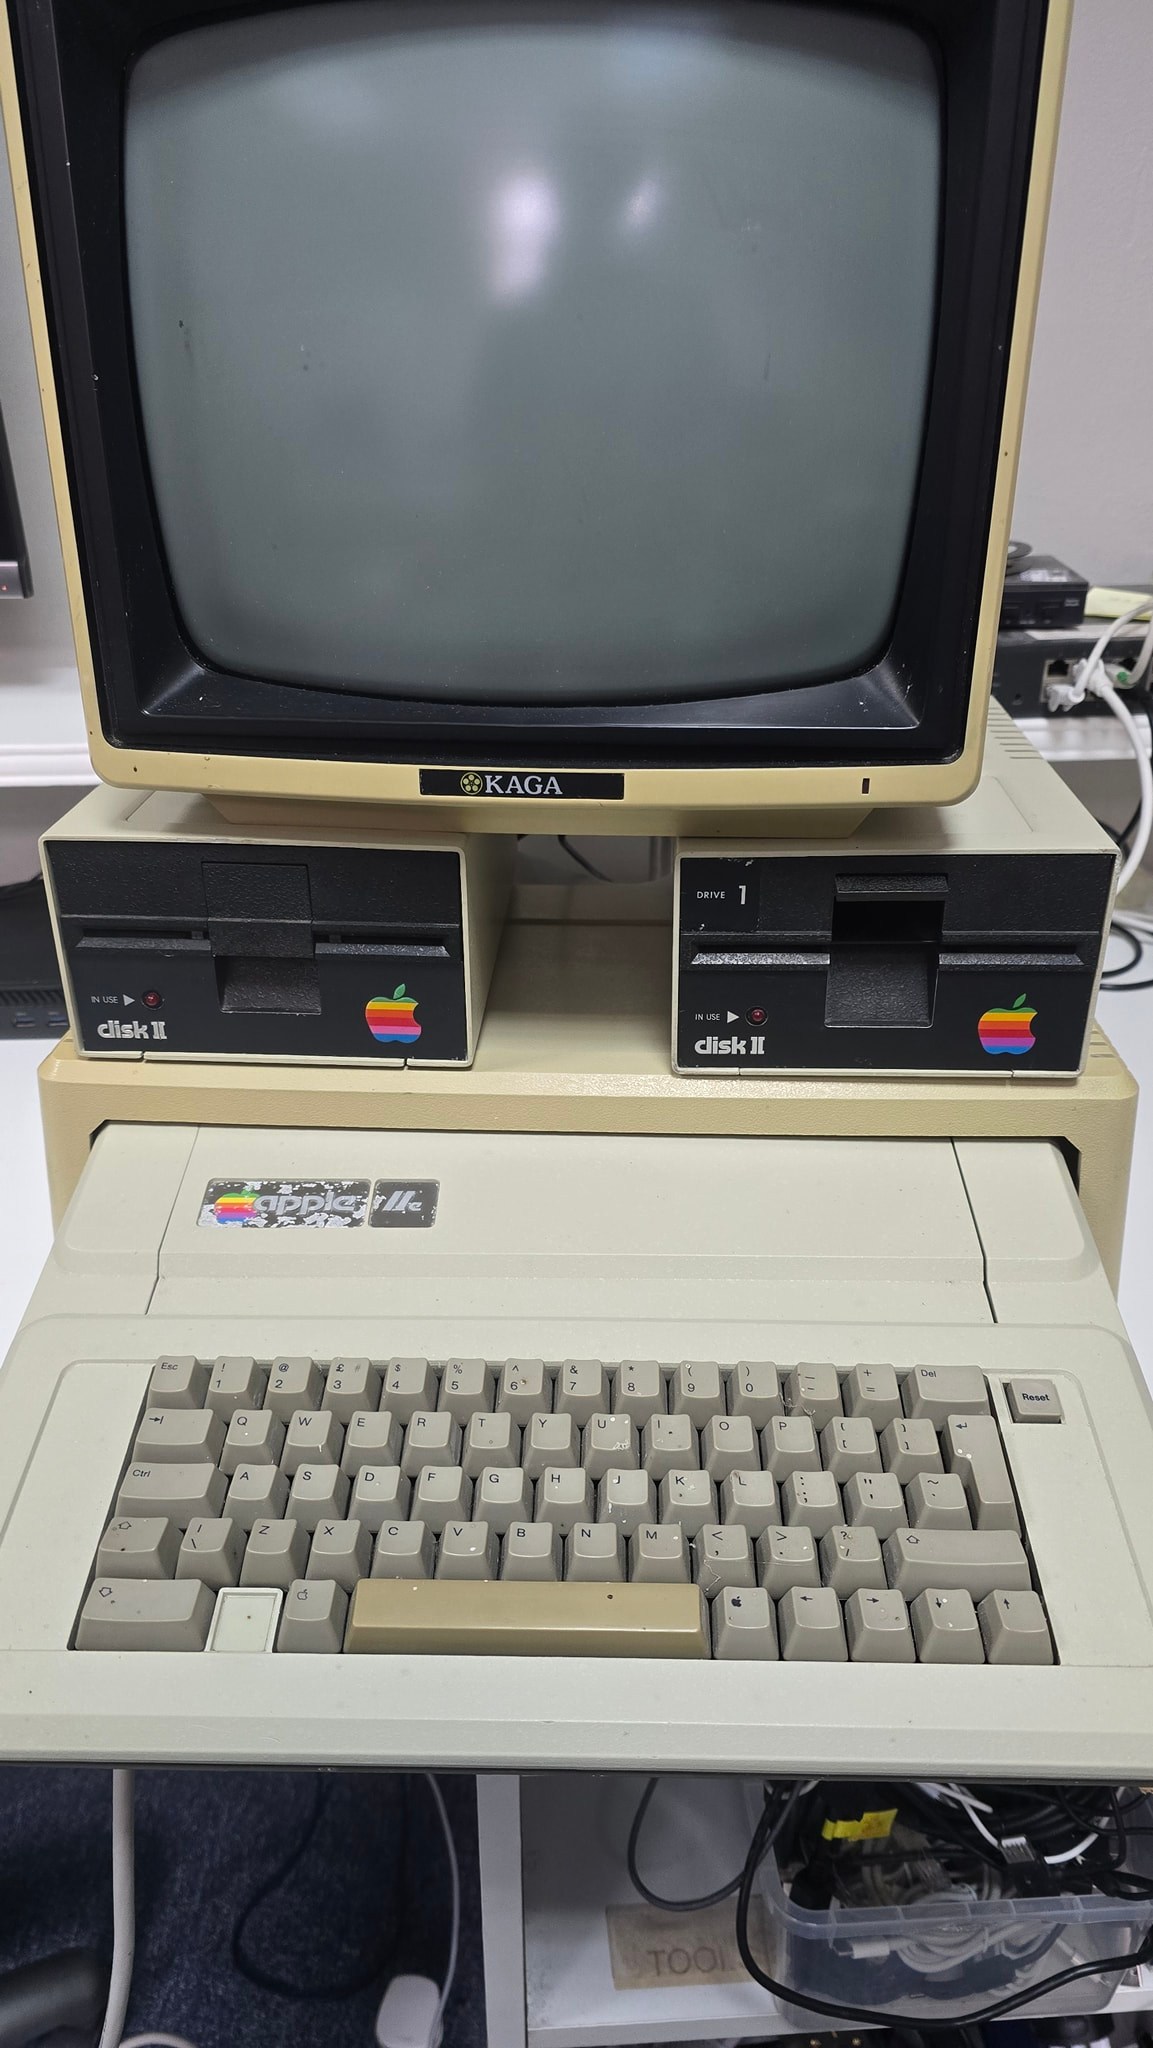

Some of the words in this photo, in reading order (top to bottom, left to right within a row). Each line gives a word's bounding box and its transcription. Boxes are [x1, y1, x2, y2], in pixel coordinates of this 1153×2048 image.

[484, 775, 563, 795] KAGA
[696, 891, 726, 899] DRIVE
[738, 885, 747, 905] 1
[102, 996, 119, 1004] USE
[695, 1013, 704, 1021] IN
[706, 1013, 720, 1021] USE
[97, 1020, 150, 1039] disk
[694, 1036, 747, 1055] disk
[253, 1190, 356, 1215] apple
[160, 1362, 178, 1371] Esc
[278, 1363, 290, 1373] @
[336, 1363, 345, 1373] £
[394, 1364, 401, 1373] $
[453, 1364, 463, 1375] %
[569, 1365, 579, 1375] &
[921, 1369, 937, 1378] Del
[215, 1379, 222, 1389] 1
[275, 1379, 284, 1389] 2
[333, 1380, 342, 1390] 3
[392, 1380, 400, 1390] 4
[451, 1381, 459, 1391] 5
[510, 1381, 519, 1391] 6
[569, 1382, 577, 1391] 7
[627, 1382, 636, 1392] 8
[687, 1383, 696, 1393] 9
[1022, 1392, 1051, 1403] Reset
[237, 1416, 249, 1427] Q
[298, 1416, 313, 1427] W
[356, 1417, 367, 1428] E
[416, 1417, 427, 1428] R
[478, 1418, 486, 1428] T
[538, 1418, 548, 1429] Y
[597, 1419, 607, 1429] U
[719, 1421, 730, 1431] O
[778, 1421, 788, 1431] P
[132, 1469, 151, 1478] Ctrl
[239, 1471, 250, 1481] A
[302, 1471, 312, 1481] S
[364, 1472, 375, 1482] D
[427, 1472, 437, 1482] F
[489, 1474, 500, 1484] G
[551, 1474, 561, 1484] H
[612, 1475, 621, 1485] J
[675, 1476, 686, 1486] K
[738, 1476, 747, 1487] L
[258, 1525, 271, 1536] Z
[323, 1525, 336, 1536] X
[387, 1526, 400, 1537] C
[453, 1527, 464, 1538] V
[516, 1528, 527, 1538] B
[581, 1528, 592, 1539] N
[645, 1530, 658, 1540] M
[840, 1530, 848, 1541] ?
[647, 1947, 745, 1977] TOOL
